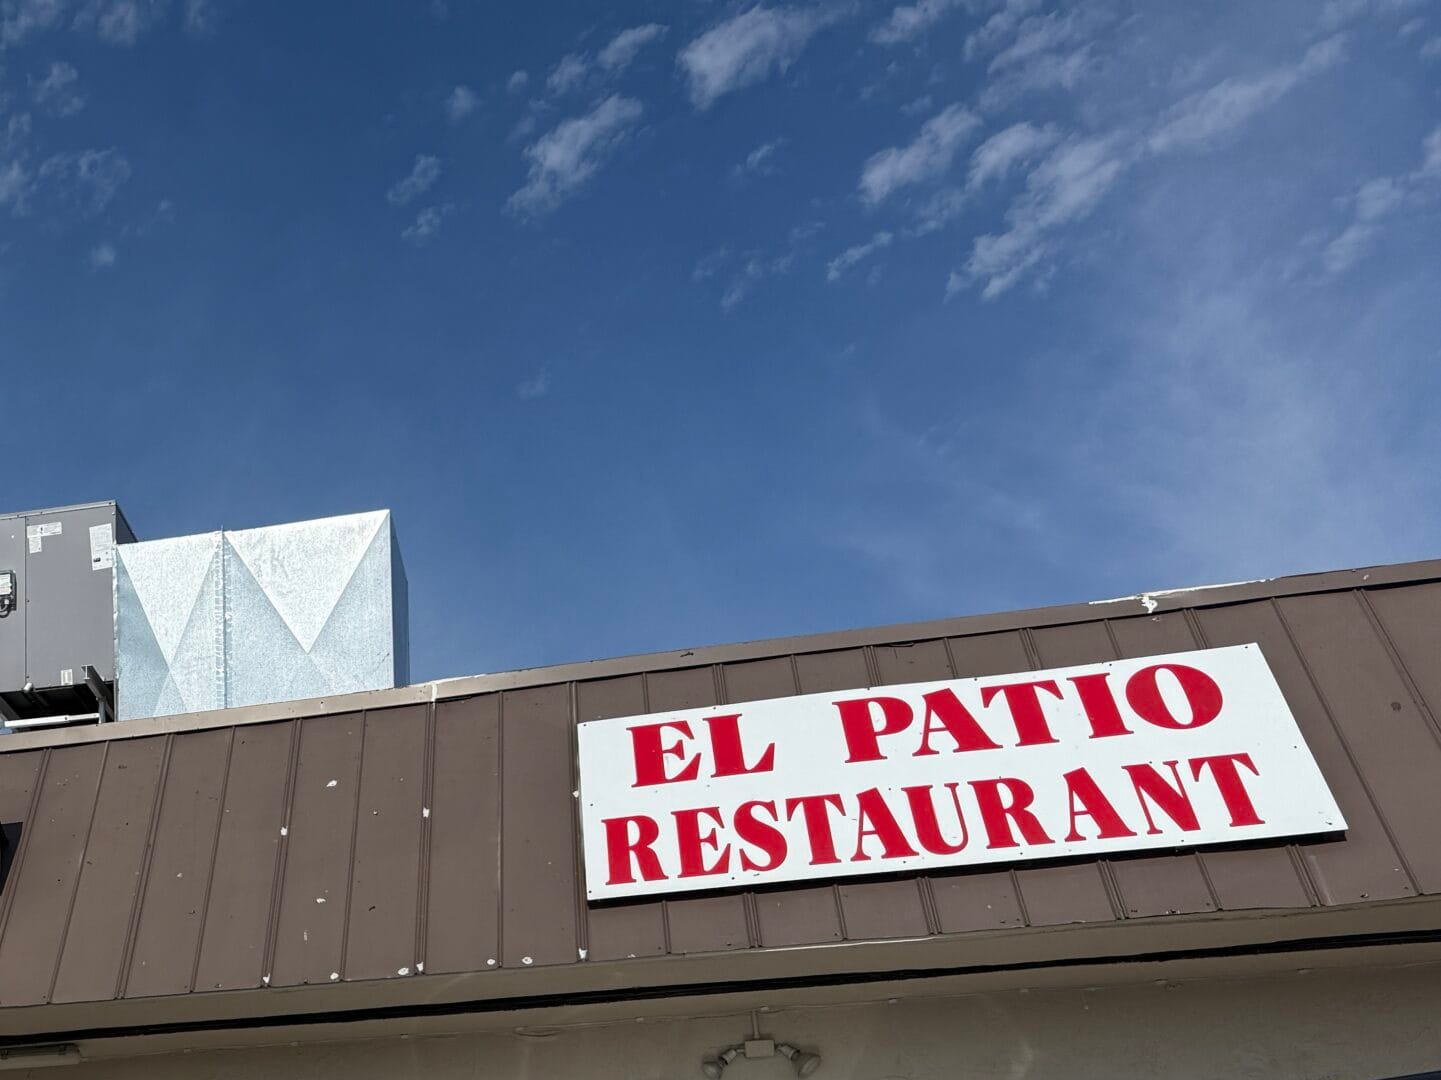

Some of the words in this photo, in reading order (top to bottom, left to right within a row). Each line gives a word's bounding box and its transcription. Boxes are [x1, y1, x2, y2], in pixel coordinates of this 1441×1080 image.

[626, 713, 775, 788] EL
[832, 663, 1224, 764] PATIO
[601, 752, 1265, 885] RESTAURANT
